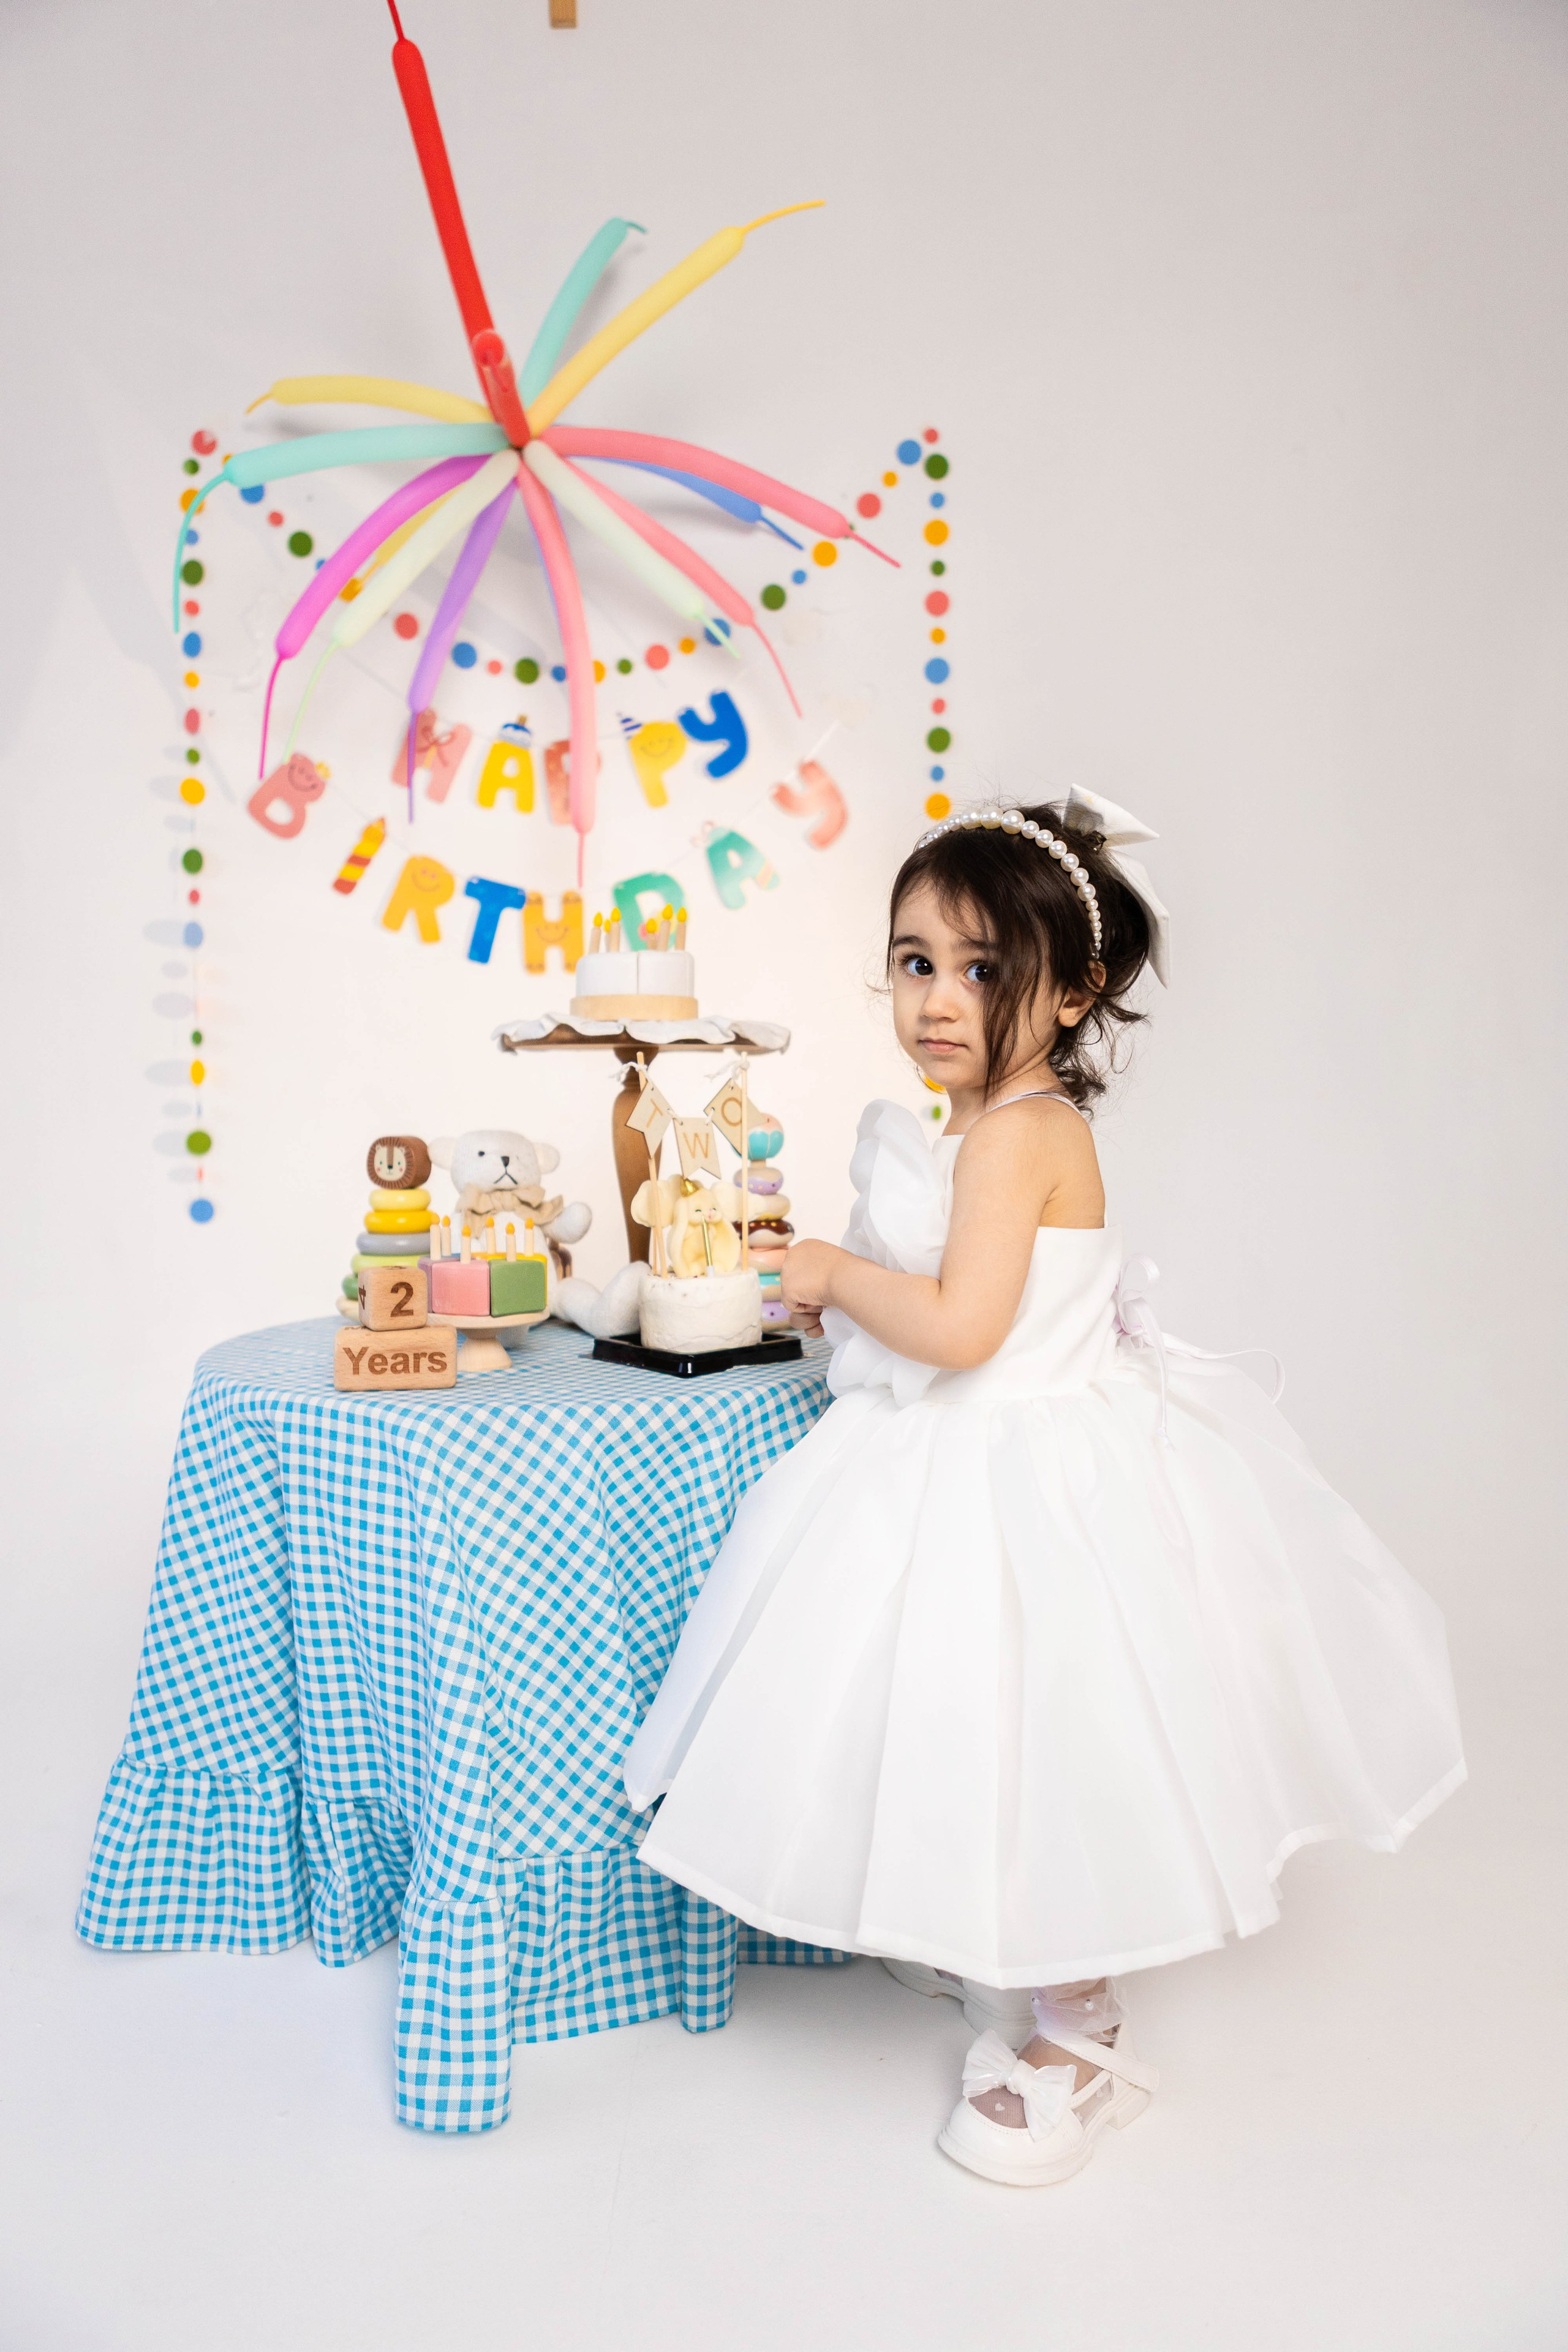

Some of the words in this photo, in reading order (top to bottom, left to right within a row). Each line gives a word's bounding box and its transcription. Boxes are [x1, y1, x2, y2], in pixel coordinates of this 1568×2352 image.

[247, 752, 849, 974] BIRTHDAY
[646, 1096, 743, 1159] TWO
[390, 1282, 414, 1317] 2
[342, 1347, 448, 1376] Years
